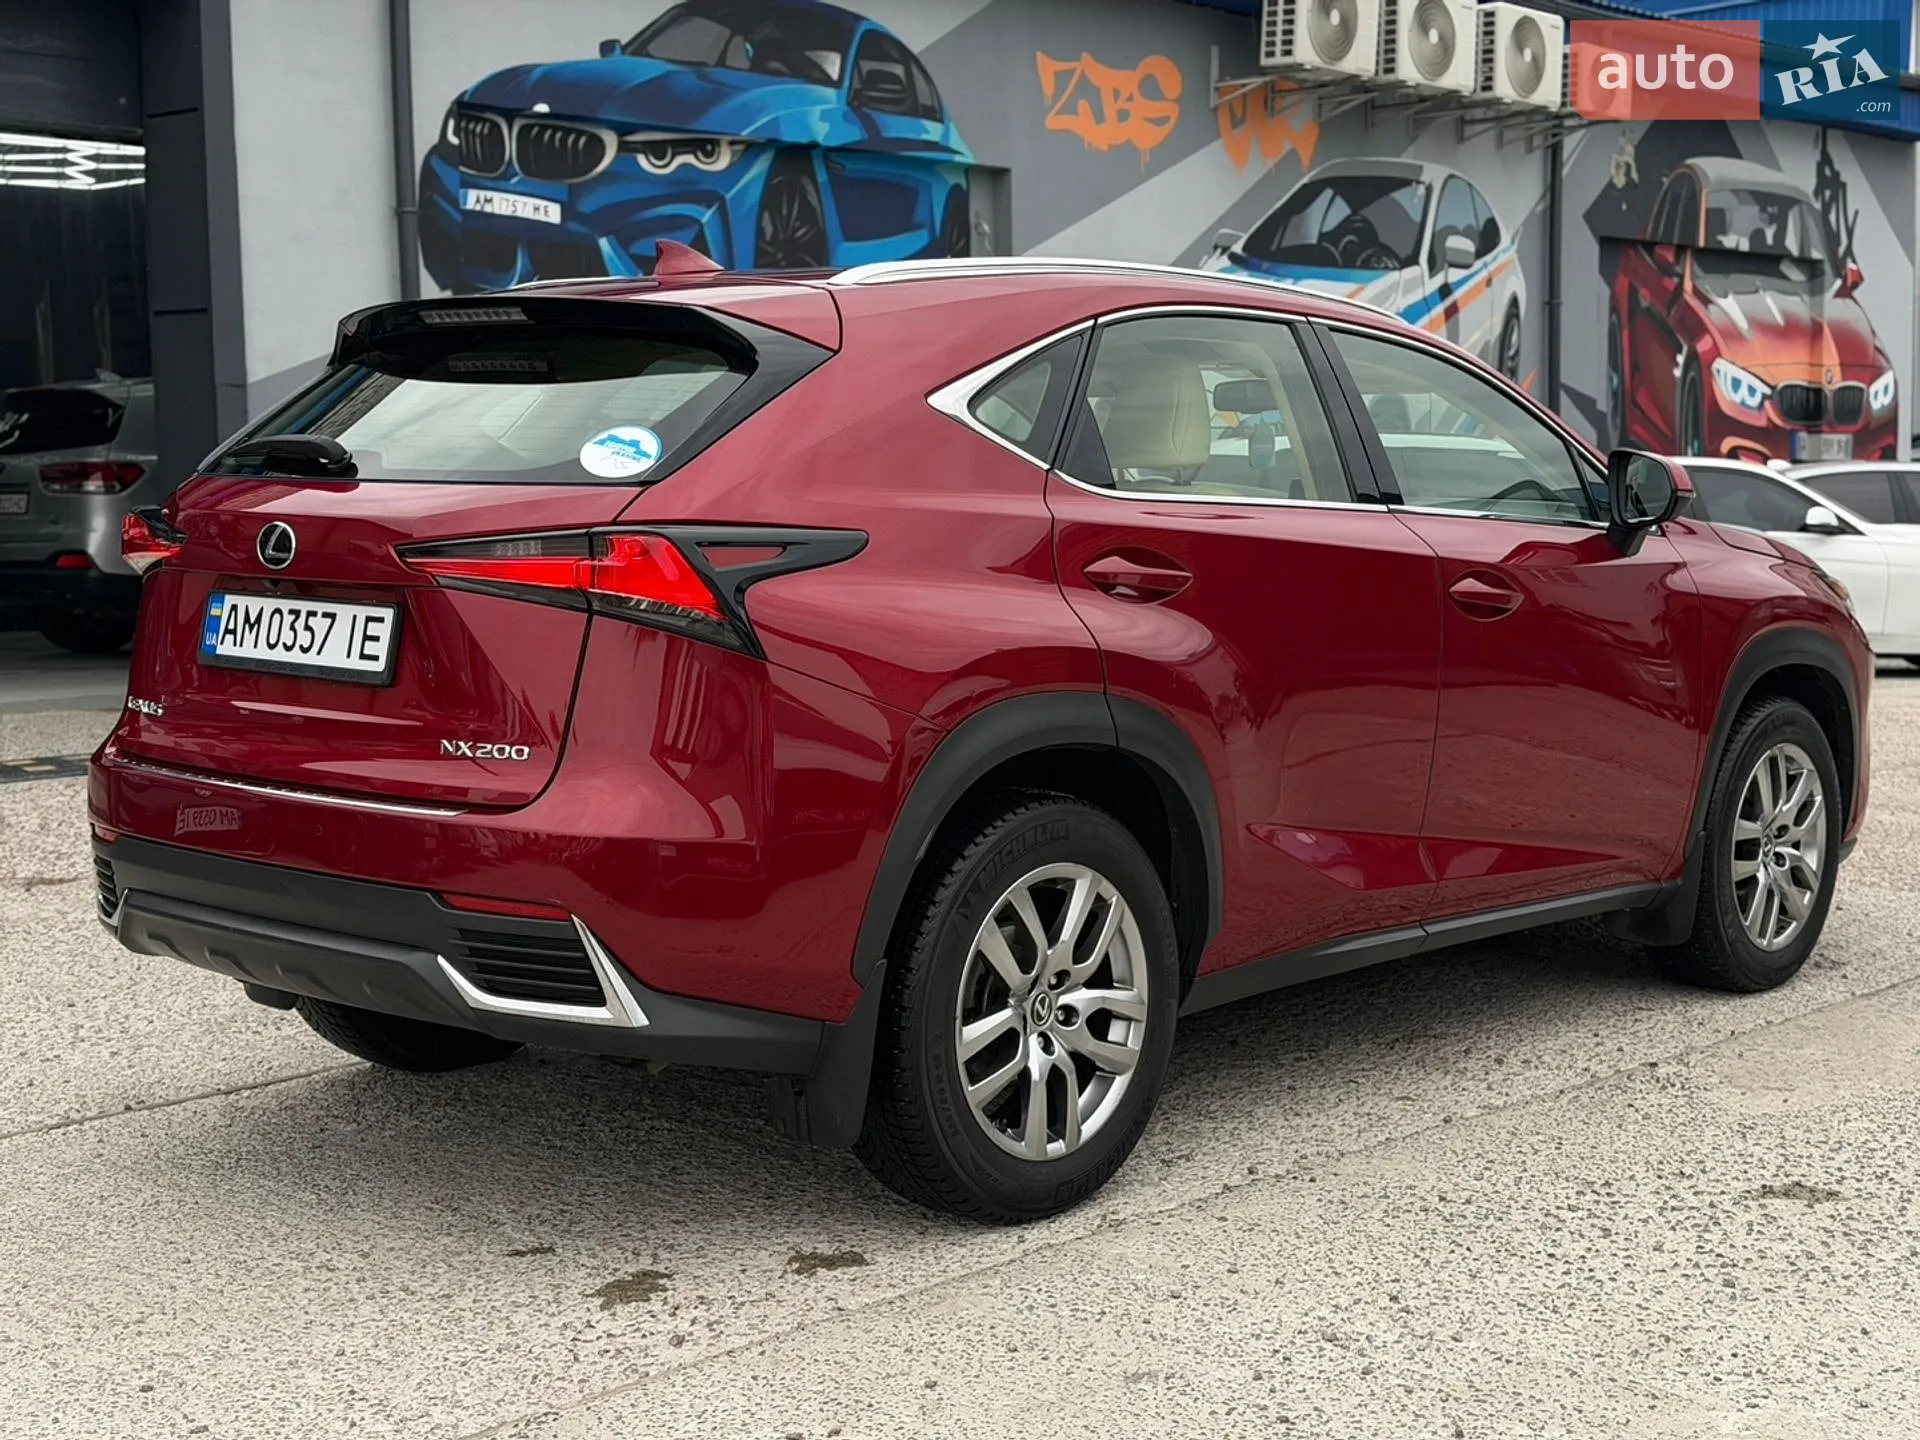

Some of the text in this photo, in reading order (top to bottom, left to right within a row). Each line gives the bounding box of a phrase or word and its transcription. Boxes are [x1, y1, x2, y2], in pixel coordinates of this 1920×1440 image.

[205, 632, 218, 646] UA
[346, 614, 386, 662] IE
[440, 739, 531, 760] NX200
